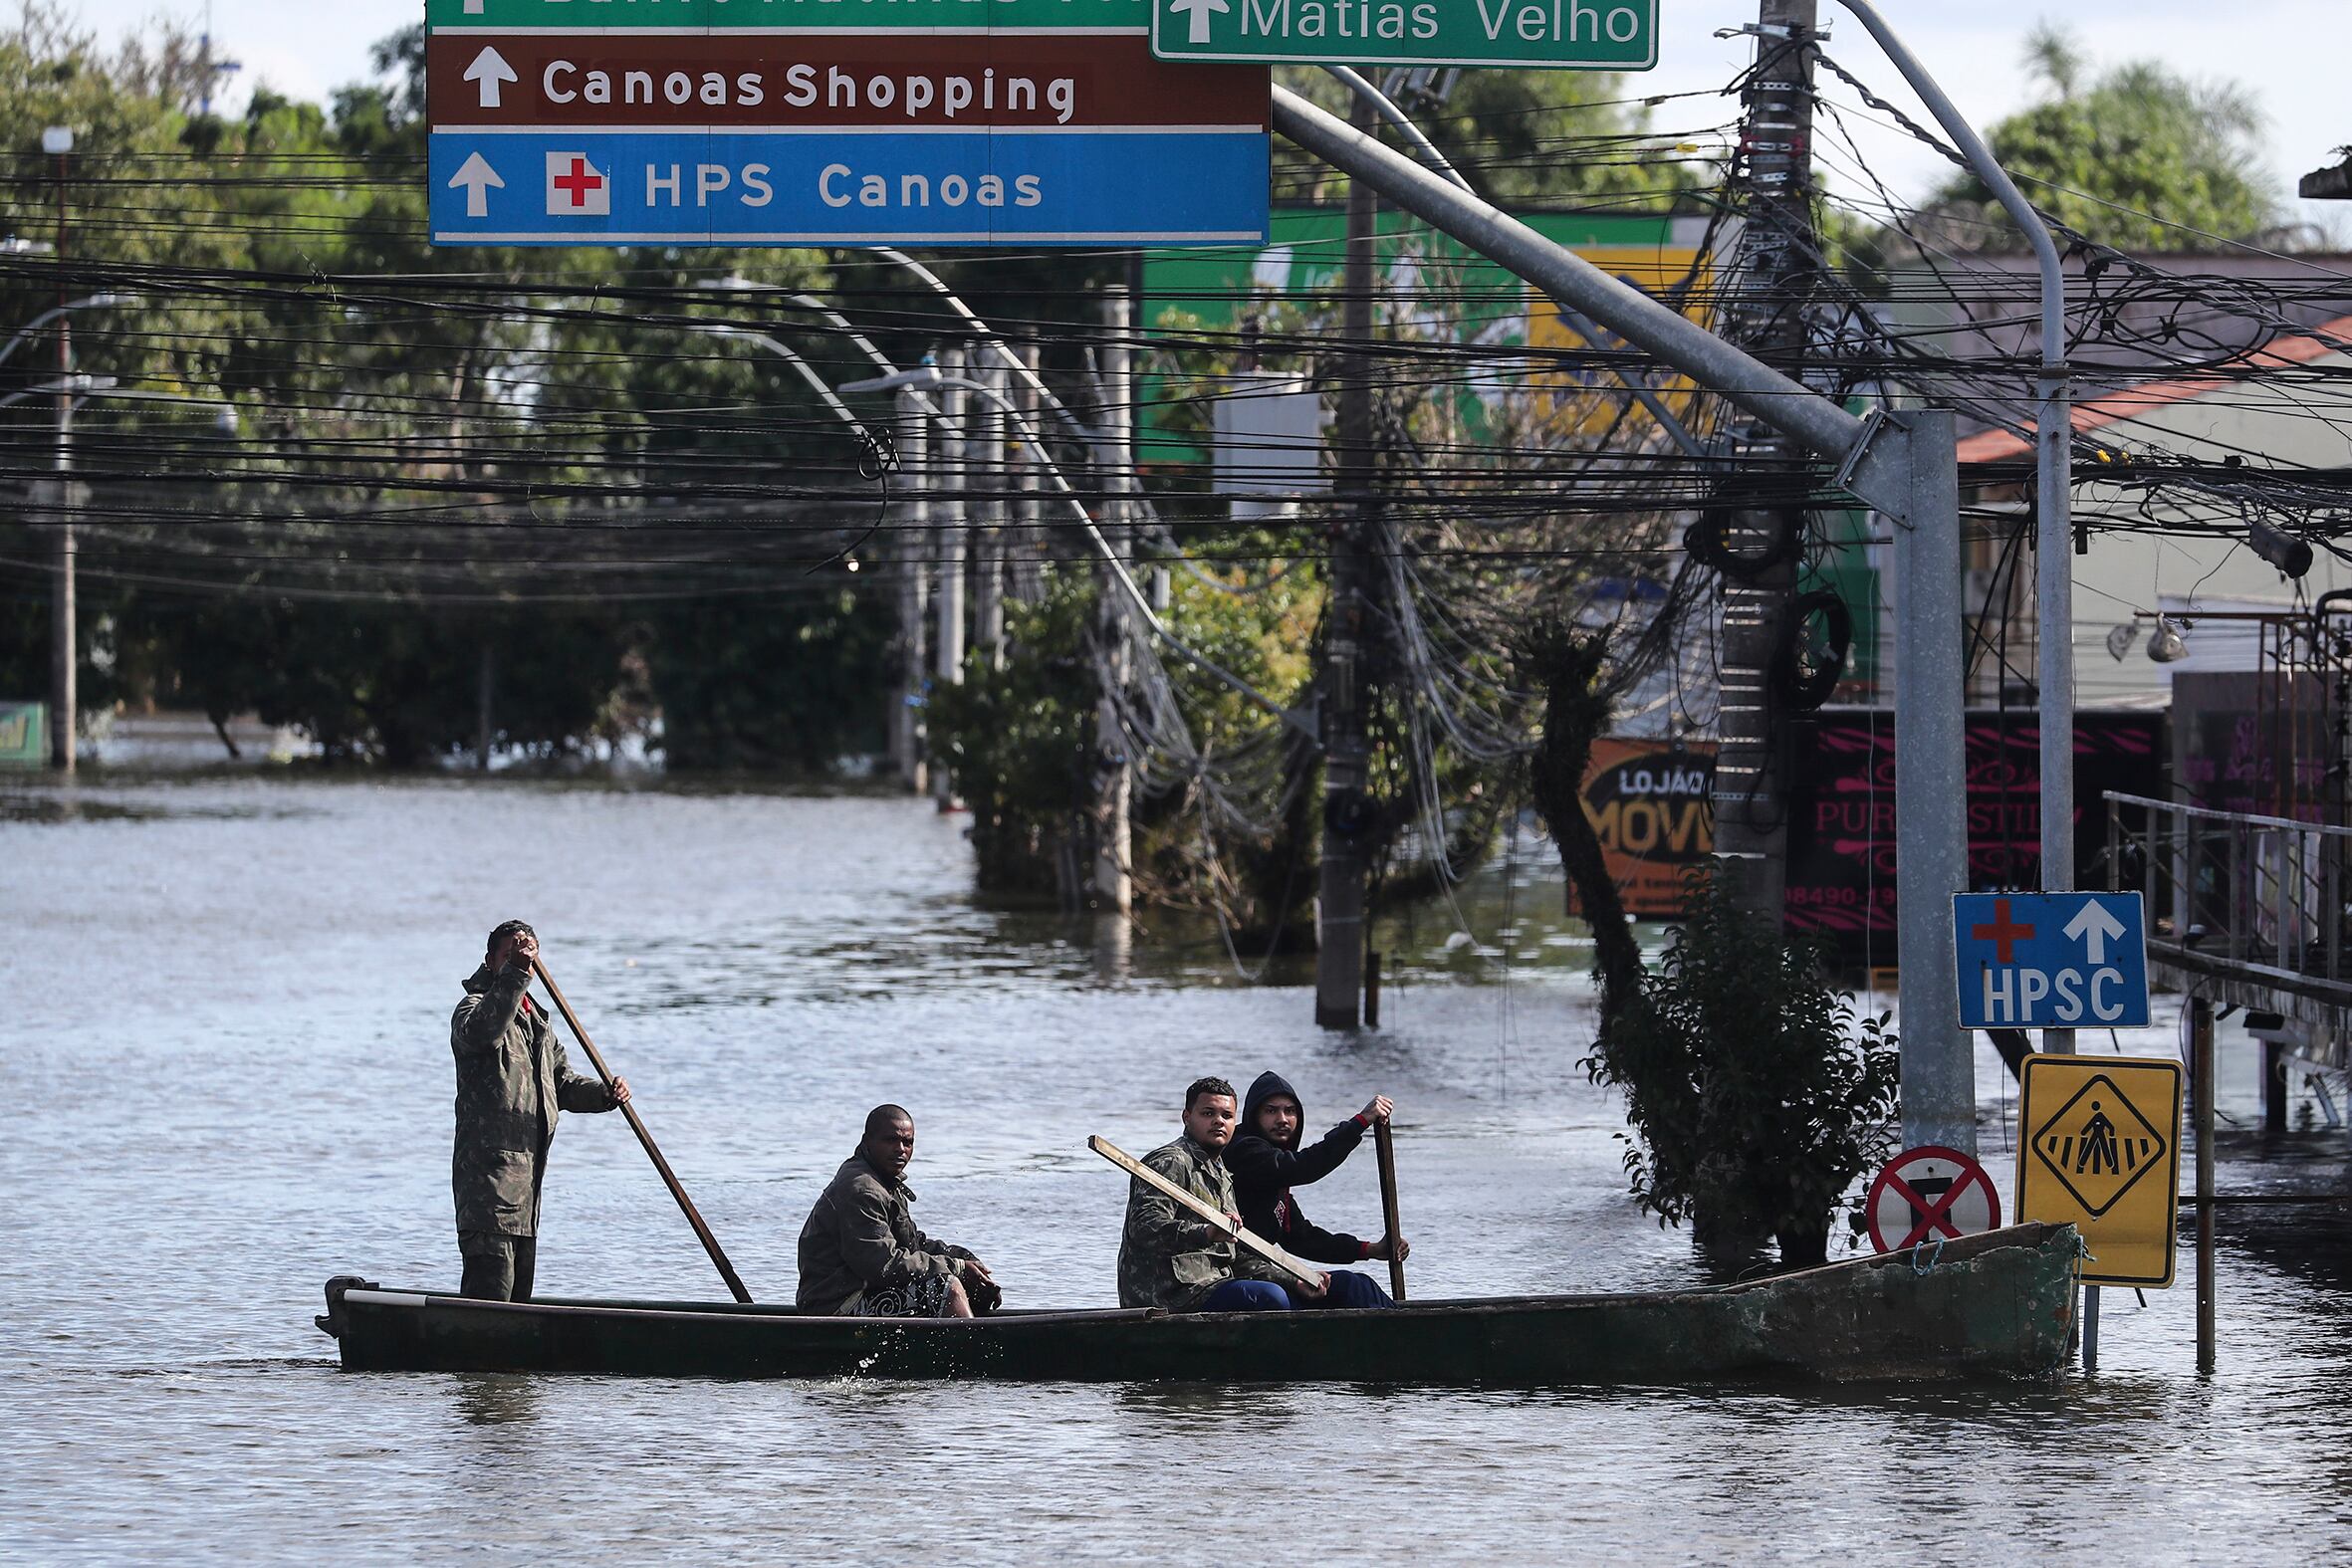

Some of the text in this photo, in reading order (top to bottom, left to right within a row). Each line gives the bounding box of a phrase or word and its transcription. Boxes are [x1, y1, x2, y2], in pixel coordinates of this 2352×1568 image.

[1241, 0, 1639, 43] Matias Velho
[543, 60, 1074, 124] Canoas Shopping
[646, 163, 1044, 208] HPS Canoas
[1983, 967, 2125, 1022] HPSC
